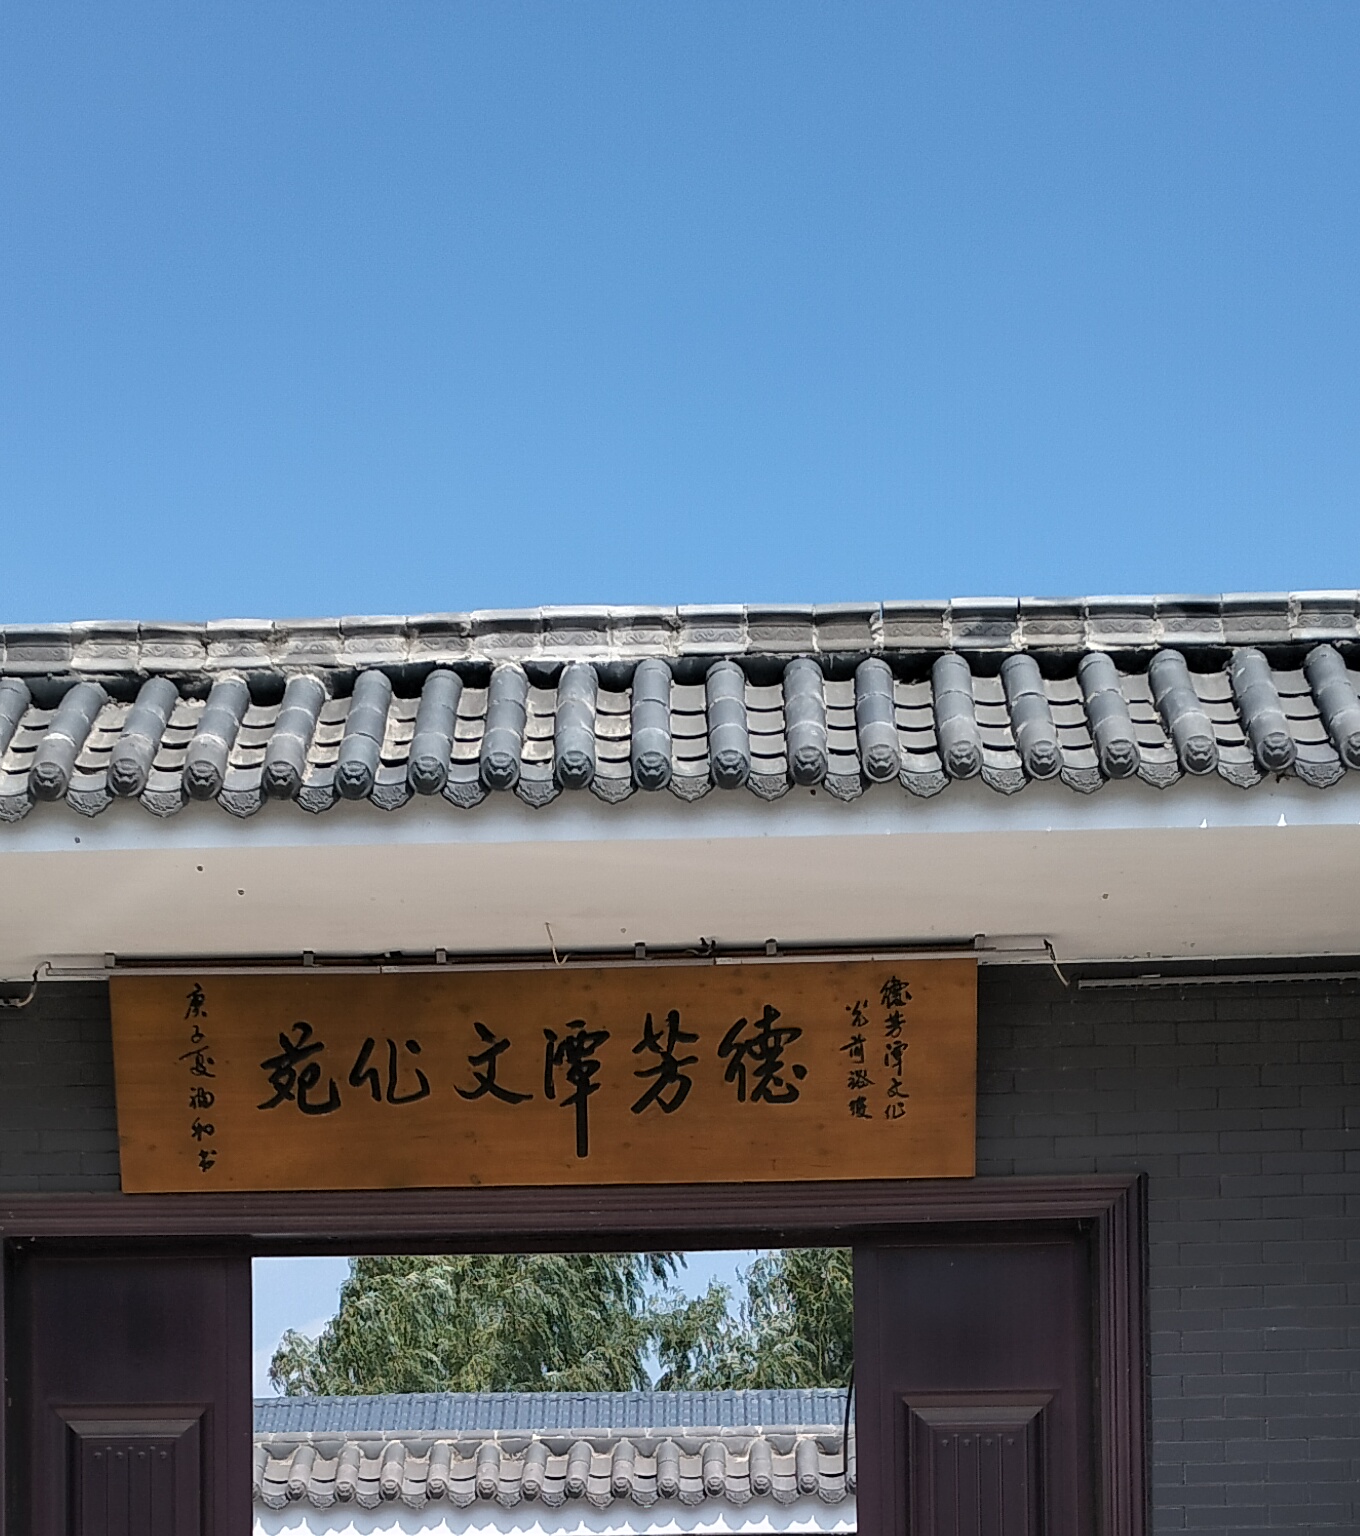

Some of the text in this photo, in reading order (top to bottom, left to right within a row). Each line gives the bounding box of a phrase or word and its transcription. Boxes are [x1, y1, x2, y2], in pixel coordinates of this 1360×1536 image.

[257, 1004, 808, 1158] 德芳潭文化苑
